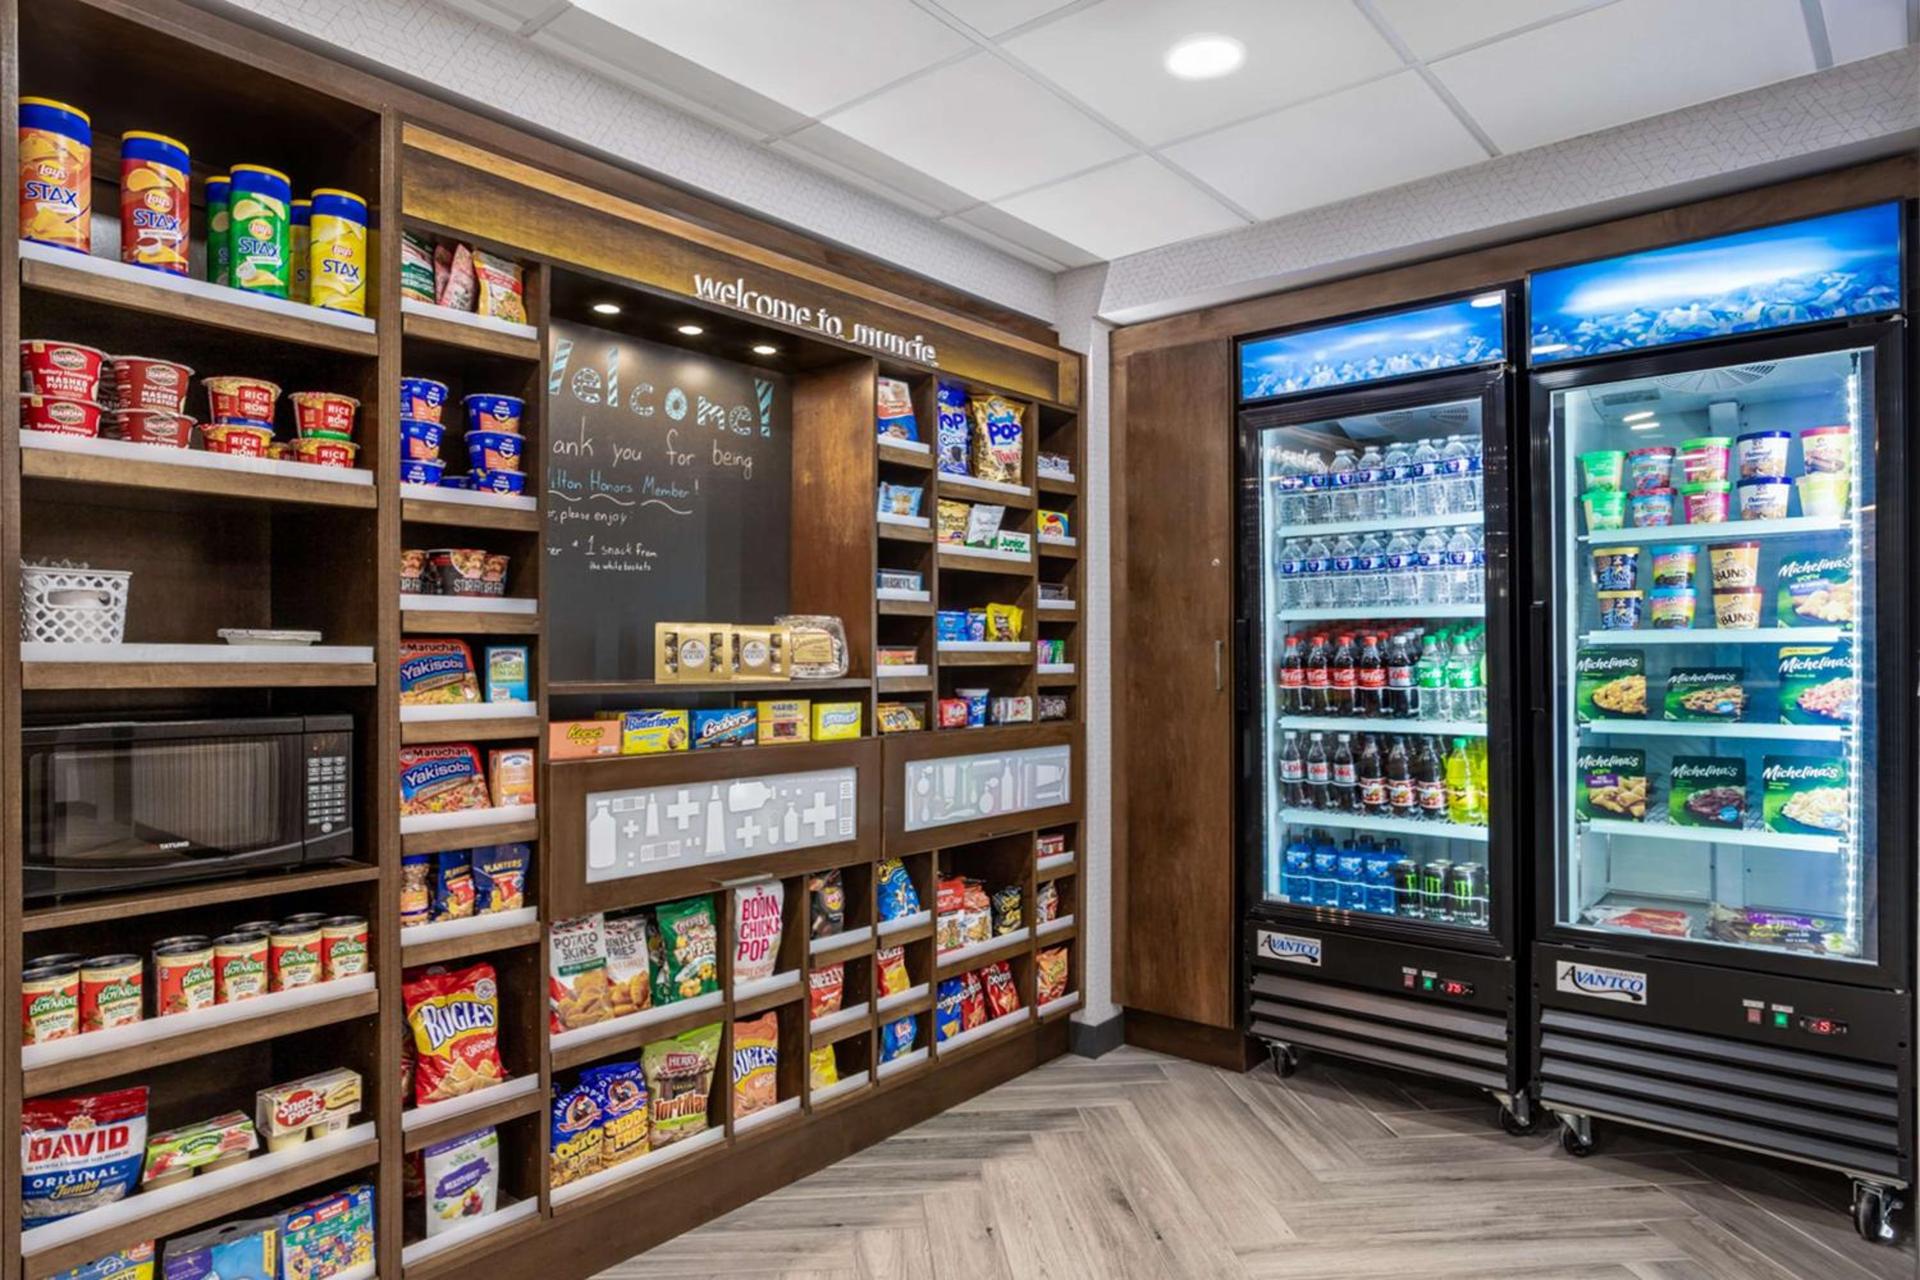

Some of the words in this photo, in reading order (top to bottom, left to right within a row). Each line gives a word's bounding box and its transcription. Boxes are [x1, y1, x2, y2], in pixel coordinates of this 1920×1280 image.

[26, 182, 78, 207] STAX
[134, 209, 180, 231] STAX
[239, 238, 280, 257] STAX
[322, 259, 360, 279] STAX
[693, 273, 812, 325] welcome
[811, 308, 845, 340] to
[846, 323, 939, 367] muncie
[244, 390, 270, 401] RICE
[327, 404, 349, 415] RICE
[231, 436, 257, 447] RICE
[987, 422, 1022, 446] POP
[321, 449, 346, 460] RICE
[613, 443, 642, 467] you
[666, 428, 696, 466] for
[713, 439, 753, 481] being
[590, 470, 634, 494] Honors
[560, 506, 590, 524] please
[594, 511, 628, 527] enjoy
[601, 542, 632, 556] snack
[636, 543, 658, 557] from
[1778, 557, 1853, 578] Michelina's
[402, 658, 464, 680] Yakisoba
[1576, 656, 1638, 672] Michelina's
[1668, 672, 1737, 685] Michelina's
[1577, 754, 1639, 769] Michelina's
[1671, 763, 1738, 779] Michelina's
[407, 762, 471, 787] Yakisoba
[1762, 763, 1840, 782] Michelina's
[483, 858, 523, 873] PLANTERS
[742, 896, 780, 921] BOOM
[553, 931, 598, 950] POTATO
[740, 921, 781, 940] CHICKA
[562, 943, 597, 960] SKINS
[737, 940, 770, 961] POP
[1261, 934, 1319, 957] AVANTCO
[1561, 965, 1643, 992] AVANTCO
[421, 1001, 495, 1051] BUGLES
[278, 1094, 324, 1119] Snack
[28, 1126, 129, 1163] DAVID
[32, 1166, 119, 1189] ORIGINAL
[49, 1180, 100, 1200] Jumbo
